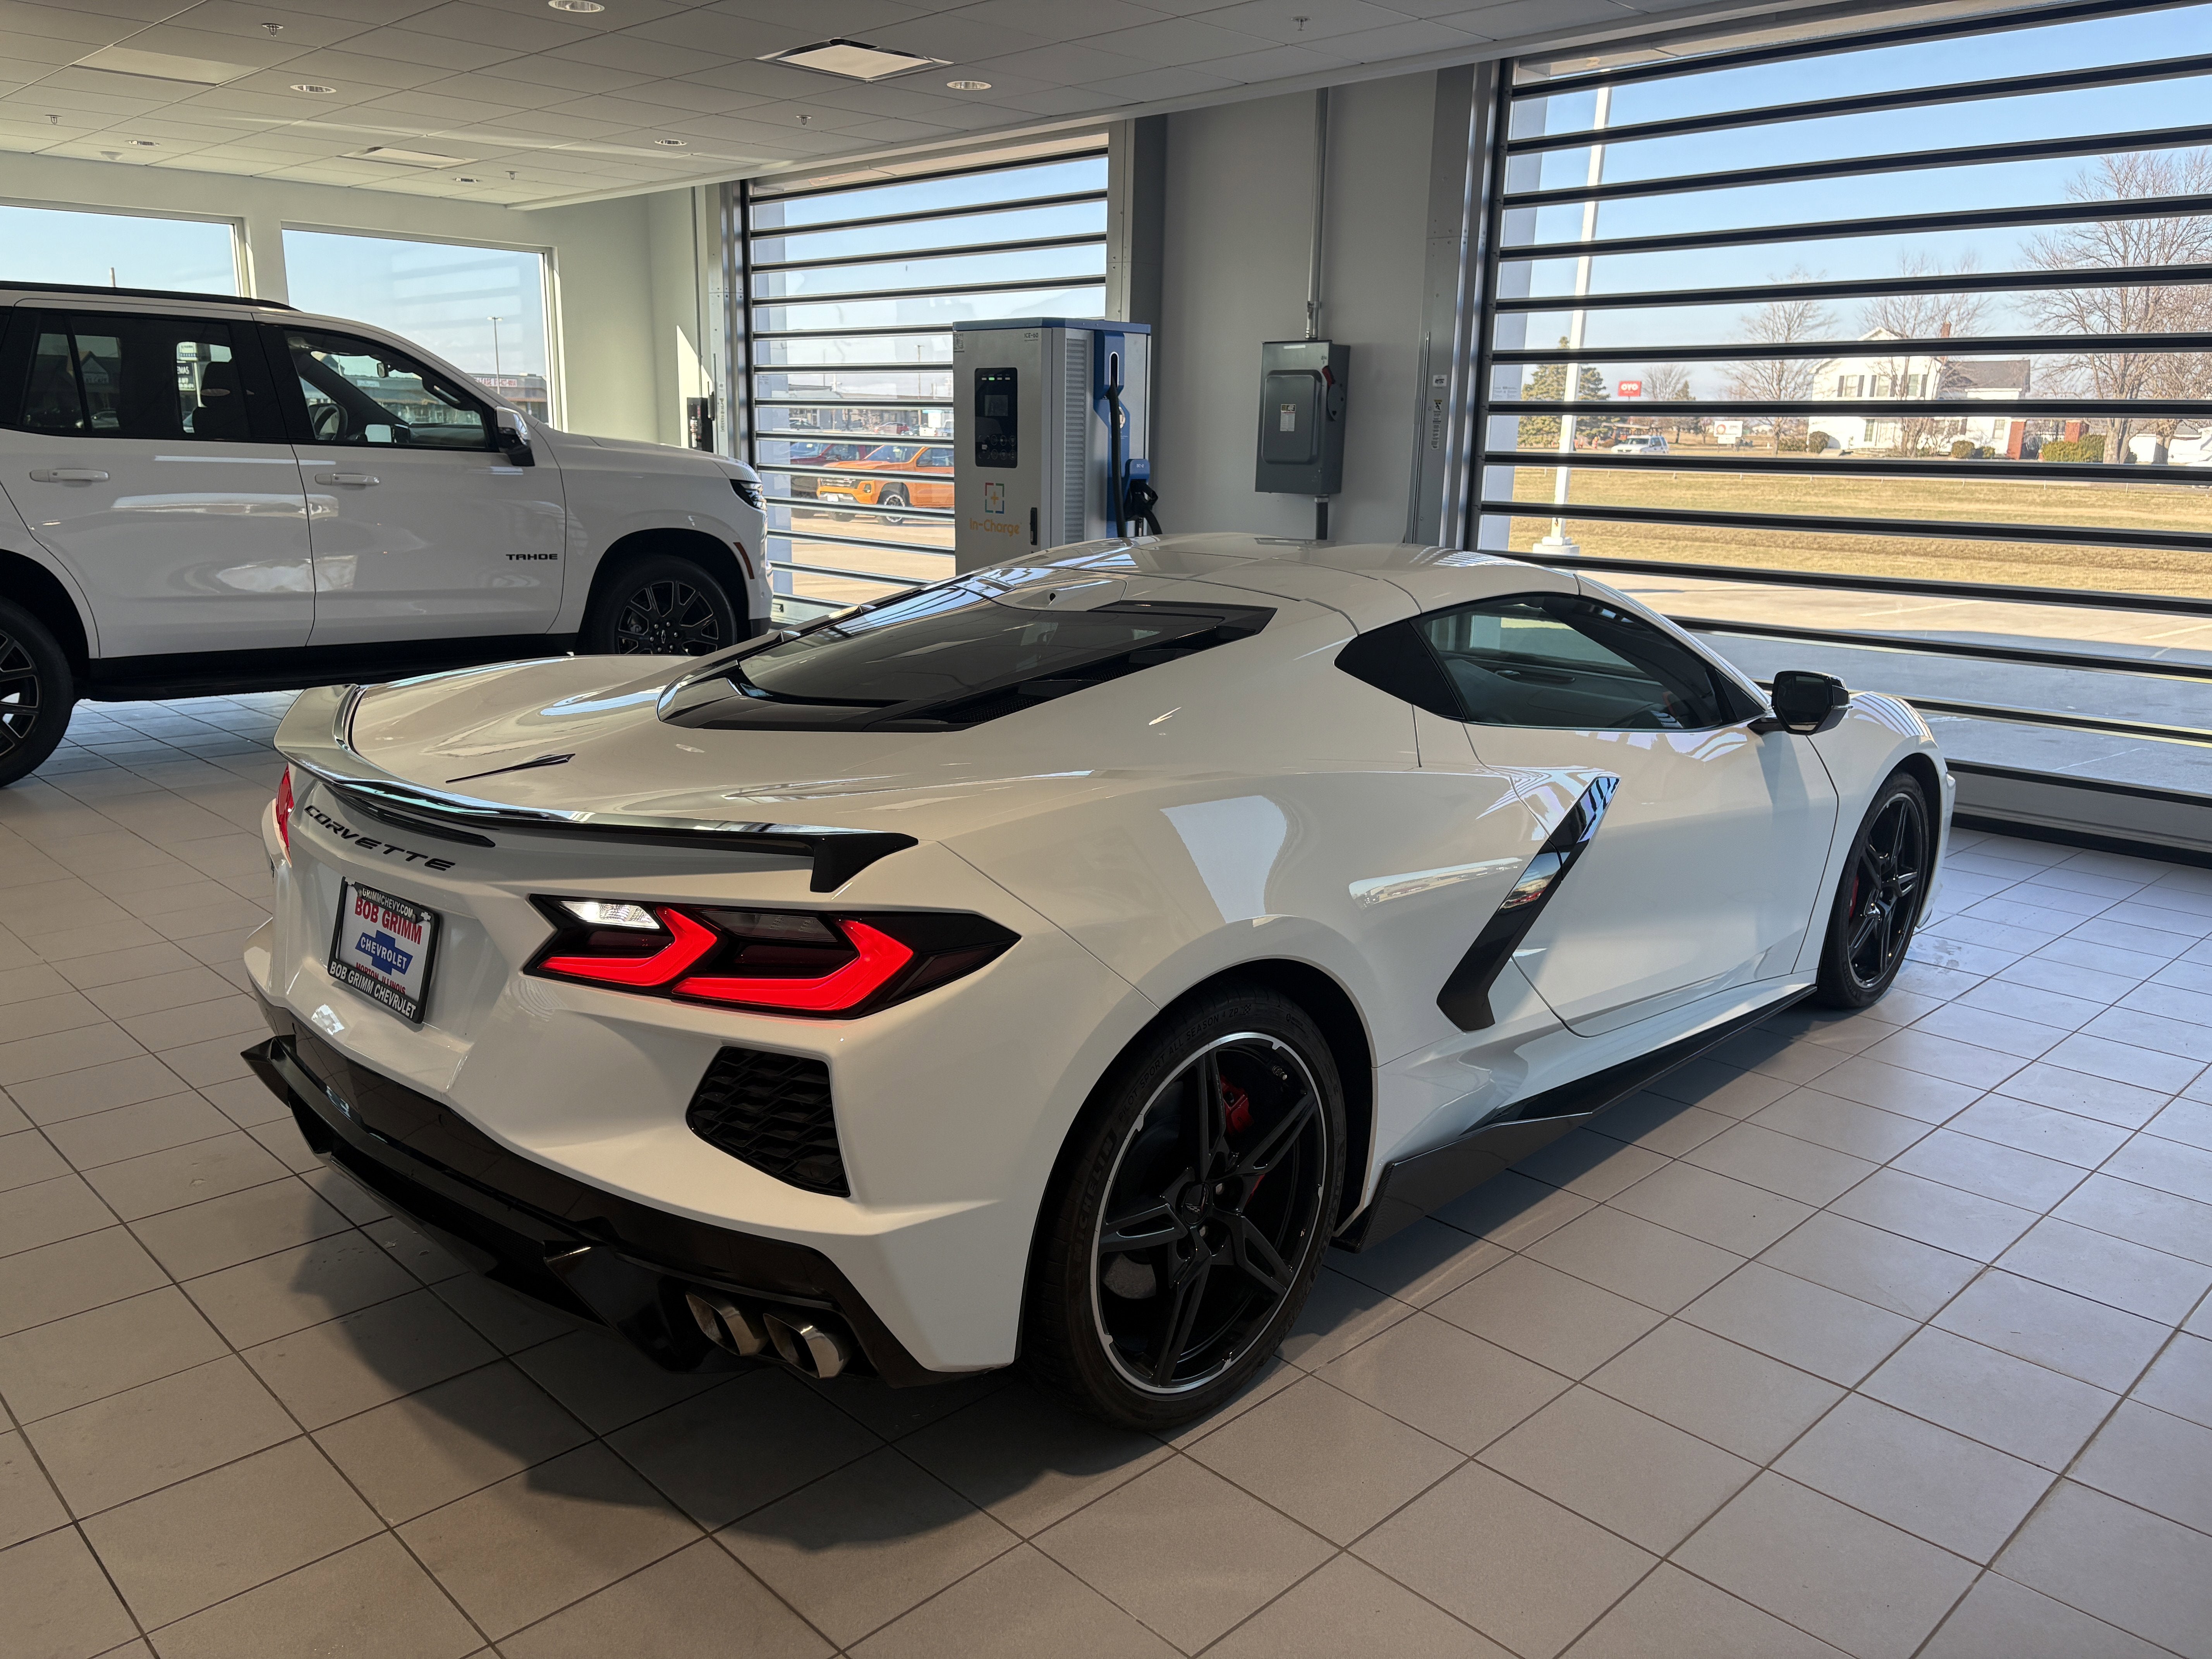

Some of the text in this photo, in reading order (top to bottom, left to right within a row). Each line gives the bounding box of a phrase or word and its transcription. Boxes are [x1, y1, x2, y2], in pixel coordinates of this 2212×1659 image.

[970, 518, 1020, 537] In-Charge
[304, 805, 456, 871] CORVETTE
[355, 896, 422, 945] BOB GRIMM
[362, 888, 413, 918] GRIMMCHEVY.COM
[361, 936, 407, 969] CHEVROLET
[330, 961, 416, 1019] BOB GRIMM CHEVROLET
[1118, 1088, 1137, 1121] PILOT
[1140, 1055, 1164, 1088] SPORT
[1169, 1039, 1183, 1055] ALL
[1186, 1014, 1219, 1041] SEASON
[1229, 1008, 1238, 1017] ZP
